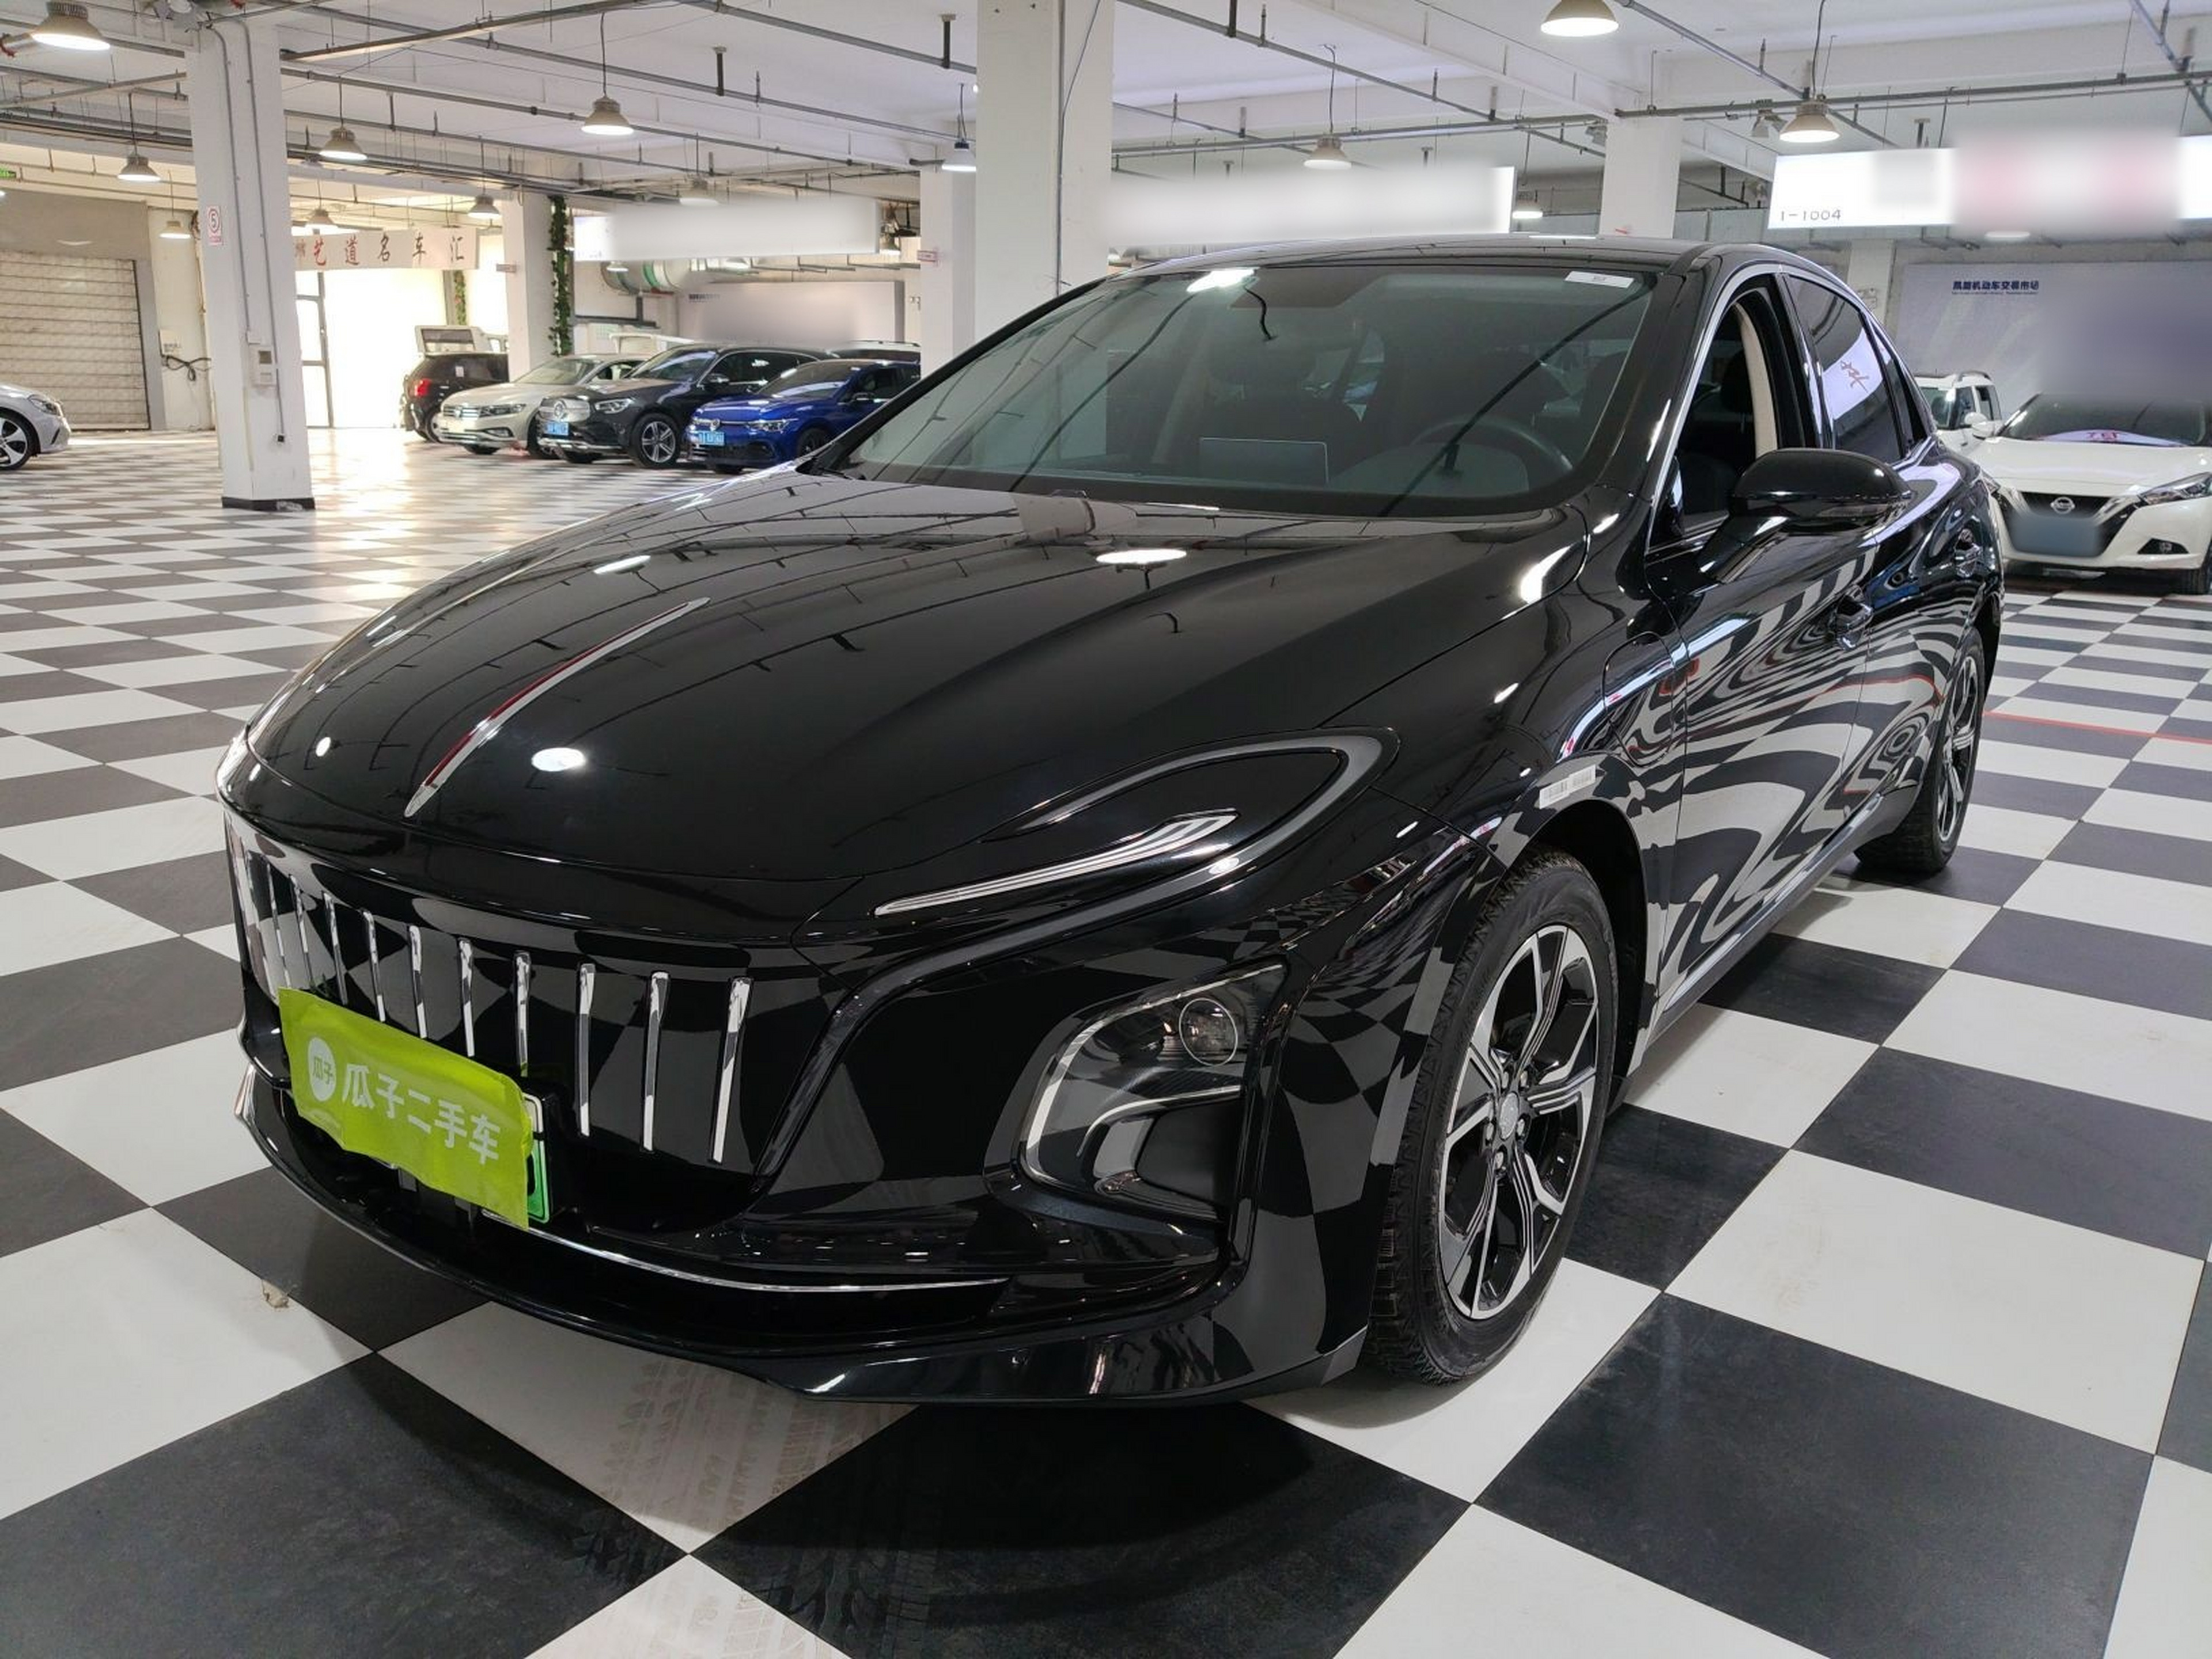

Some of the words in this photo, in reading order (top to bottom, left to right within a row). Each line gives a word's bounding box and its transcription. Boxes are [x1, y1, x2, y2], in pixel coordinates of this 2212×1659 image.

[313, 1056, 334, 1085] 瓜子
[342, 1063, 501, 1165] 瓜子二手车
